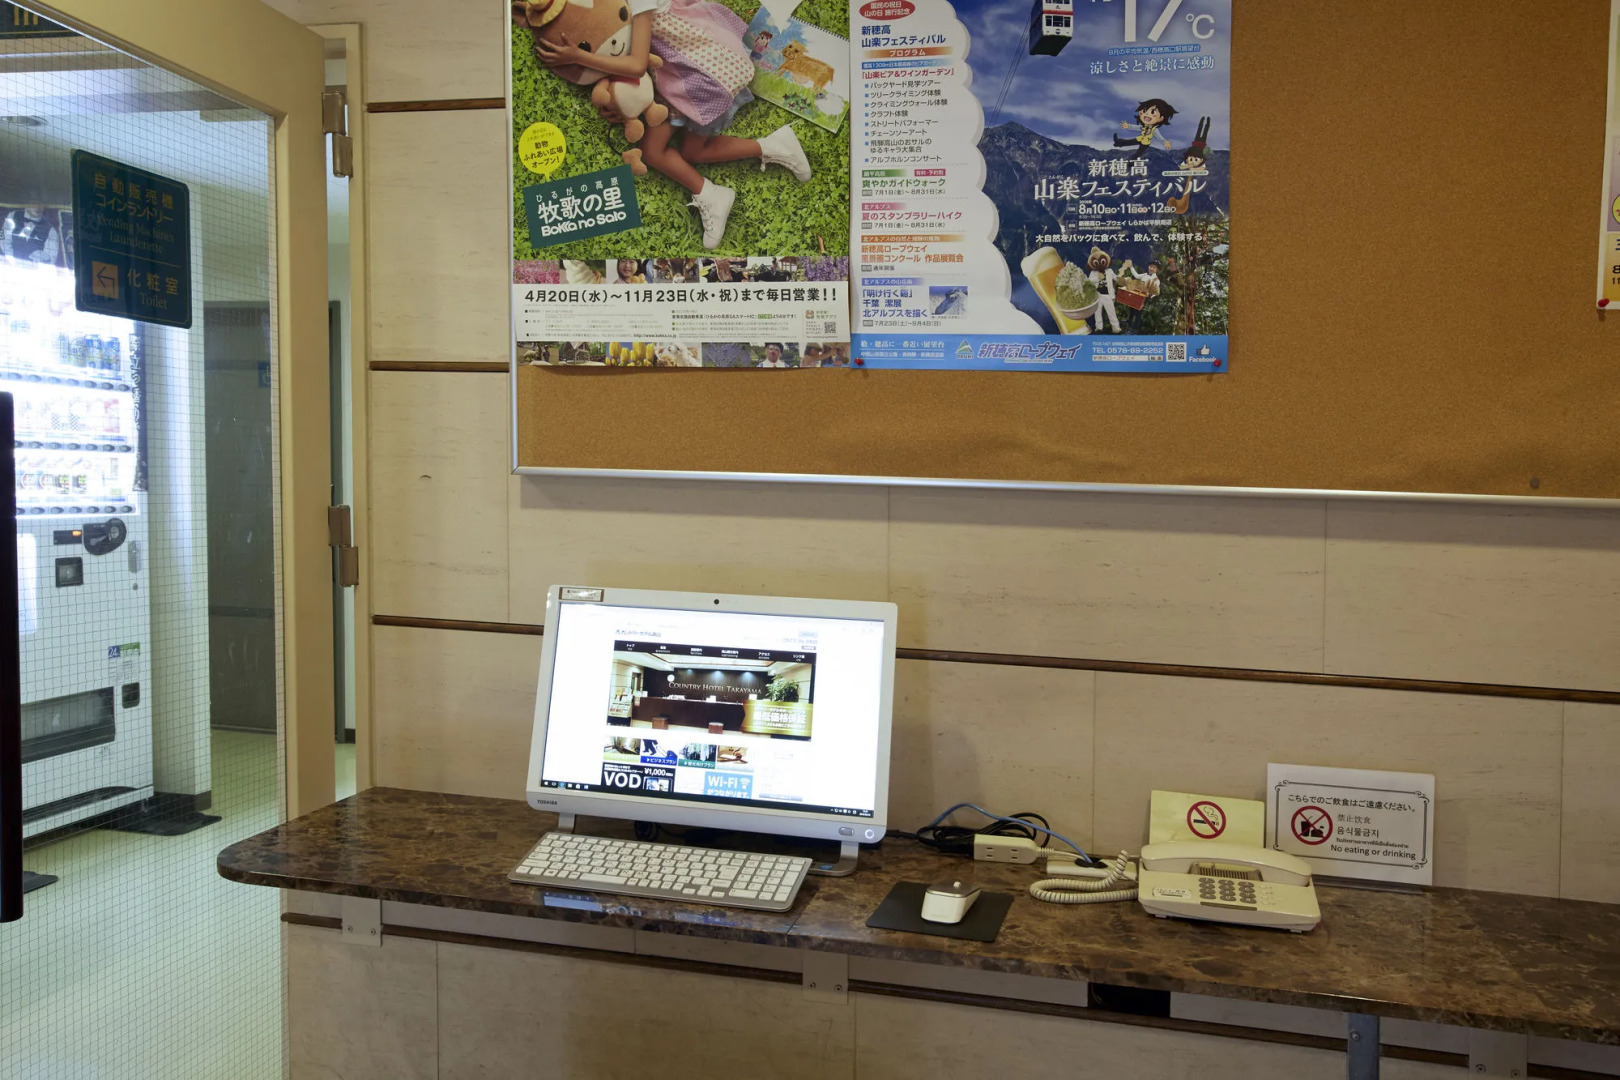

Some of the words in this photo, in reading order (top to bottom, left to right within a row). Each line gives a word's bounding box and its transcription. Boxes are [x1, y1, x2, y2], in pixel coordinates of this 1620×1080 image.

[861, 24, 891, 36] 新穂高
[861, 34, 946, 48] 山楽フェスティバル
[889, 49, 926, 57] プログラム
[1090, 56, 1214, 75] 涼しさと絶景に感動
[870, 79, 941, 89] バックヤード見学ツアー
[870, 89, 942, 98] ツリークライミング体験
[870, 98, 948, 108] クライミングウォール体験
[870, 110, 909, 118] クラフト体験
[870, 119, 939, 128] ストリートパフォーマー
[870, 129, 928, 138] チェーンソーアート
[534, 140, 548, 150] 動物
[870, 138, 932, 147] 飛騨高山のおサルの
[523, 145, 564, 162] ふれあい広場
[870, 146, 922, 154] ゆるキャラ大集合
[1087, 157, 1149, 177] 新穂高
[862, 178, 946, 188] 爽やかガイドウォーク
[1034, 177, 1207, 200] 山楽フェスティバル
[94, 173, 173, 210] 自動販売機
[535, 177, 619, 203] ひるがの高原
[95, 194, 173, 224] コインランドリー
[537, 186, 625, 226] 牧歌の里
[579, 217, 595, 230] no
[596, 211, 627, 225] Sato
[861, 211, 962, 221] 夏のスタンプラリーハイク
[97, 215, 134, 234] Vending
[1035, 232, 1207, 242] 大自然をバックに食べて、飲んで、体験する。
[861, 245, 928, 253] 新穂高ロープウェイ
[127, 267, 179, 296] 化粧室
[140, 292, 168, 310] Toilet
[862, 309, 928, 318] 北アルプスを描く
[977, 342, 1082, 359] 新穂高ロープウェイ
[668, 681, 702, 691] COUNTRY
[702, 683, 724, 693] HOTEL
[726, 685, 762, 695] TAKAYAMA
[650, 757, 677, 765] ビジネスプラン
[644, 768, 667, 777] ¥1,000
[603, 772, 642, 789] VOD
[1287, 794, 1416, 813] こちらでのご飲食はご遠慮ください。
[1337, 813, 1371, 825] 禁止饮食
[1336, 826, 1380, 839] 음식물금지
[1330, 844, 1343, 853] No
[1344, 846, 1370, 857] eating
[1382, 849, 1416, 861] drinking
